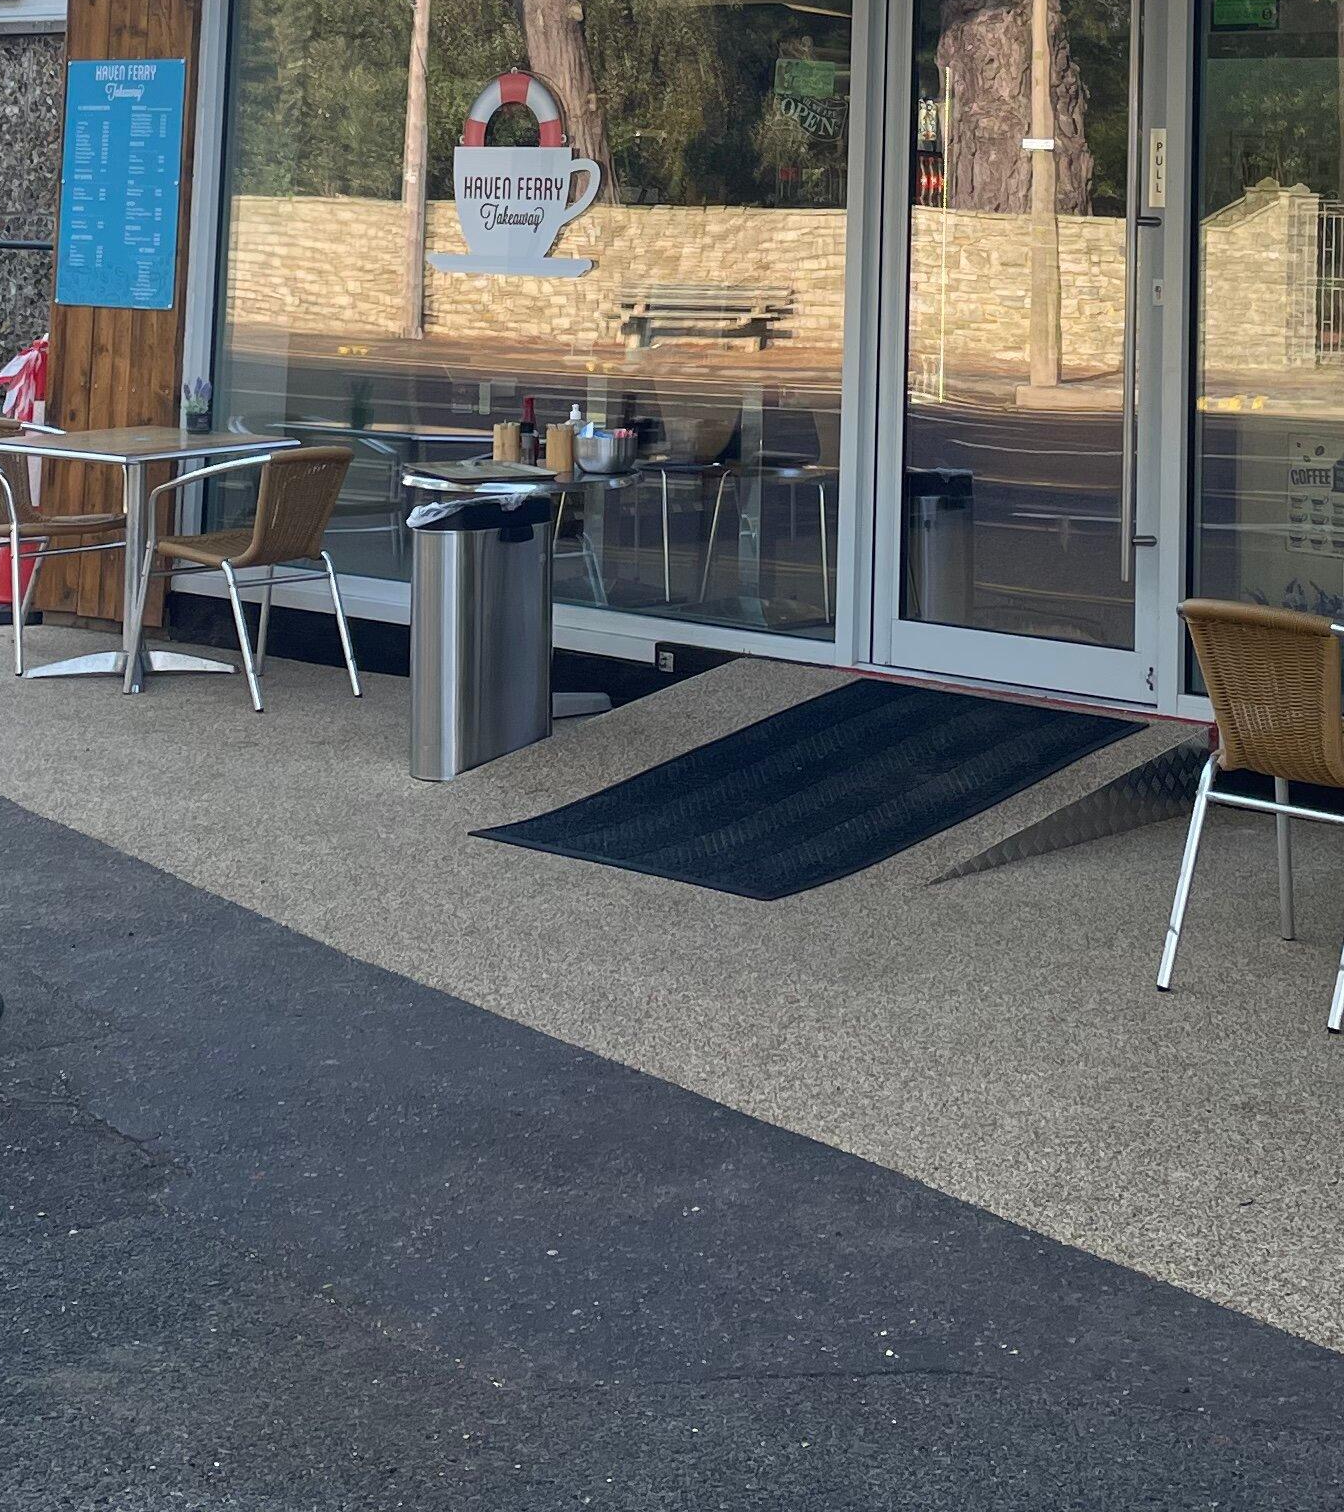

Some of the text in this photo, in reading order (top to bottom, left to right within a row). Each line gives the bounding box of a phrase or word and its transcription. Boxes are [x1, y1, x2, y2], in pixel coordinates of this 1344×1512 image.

[95, 64, 157, 82] HAVEN FERRY
[780, 97, 836, 136] OPEN
[1155, 142, 1164, 194] PULL
[463, 176, 564, 201] HAVEN FERRY
[479, 202, 545, 234] Takeaway
[1290, 468, 1331, 486] COFFEE
